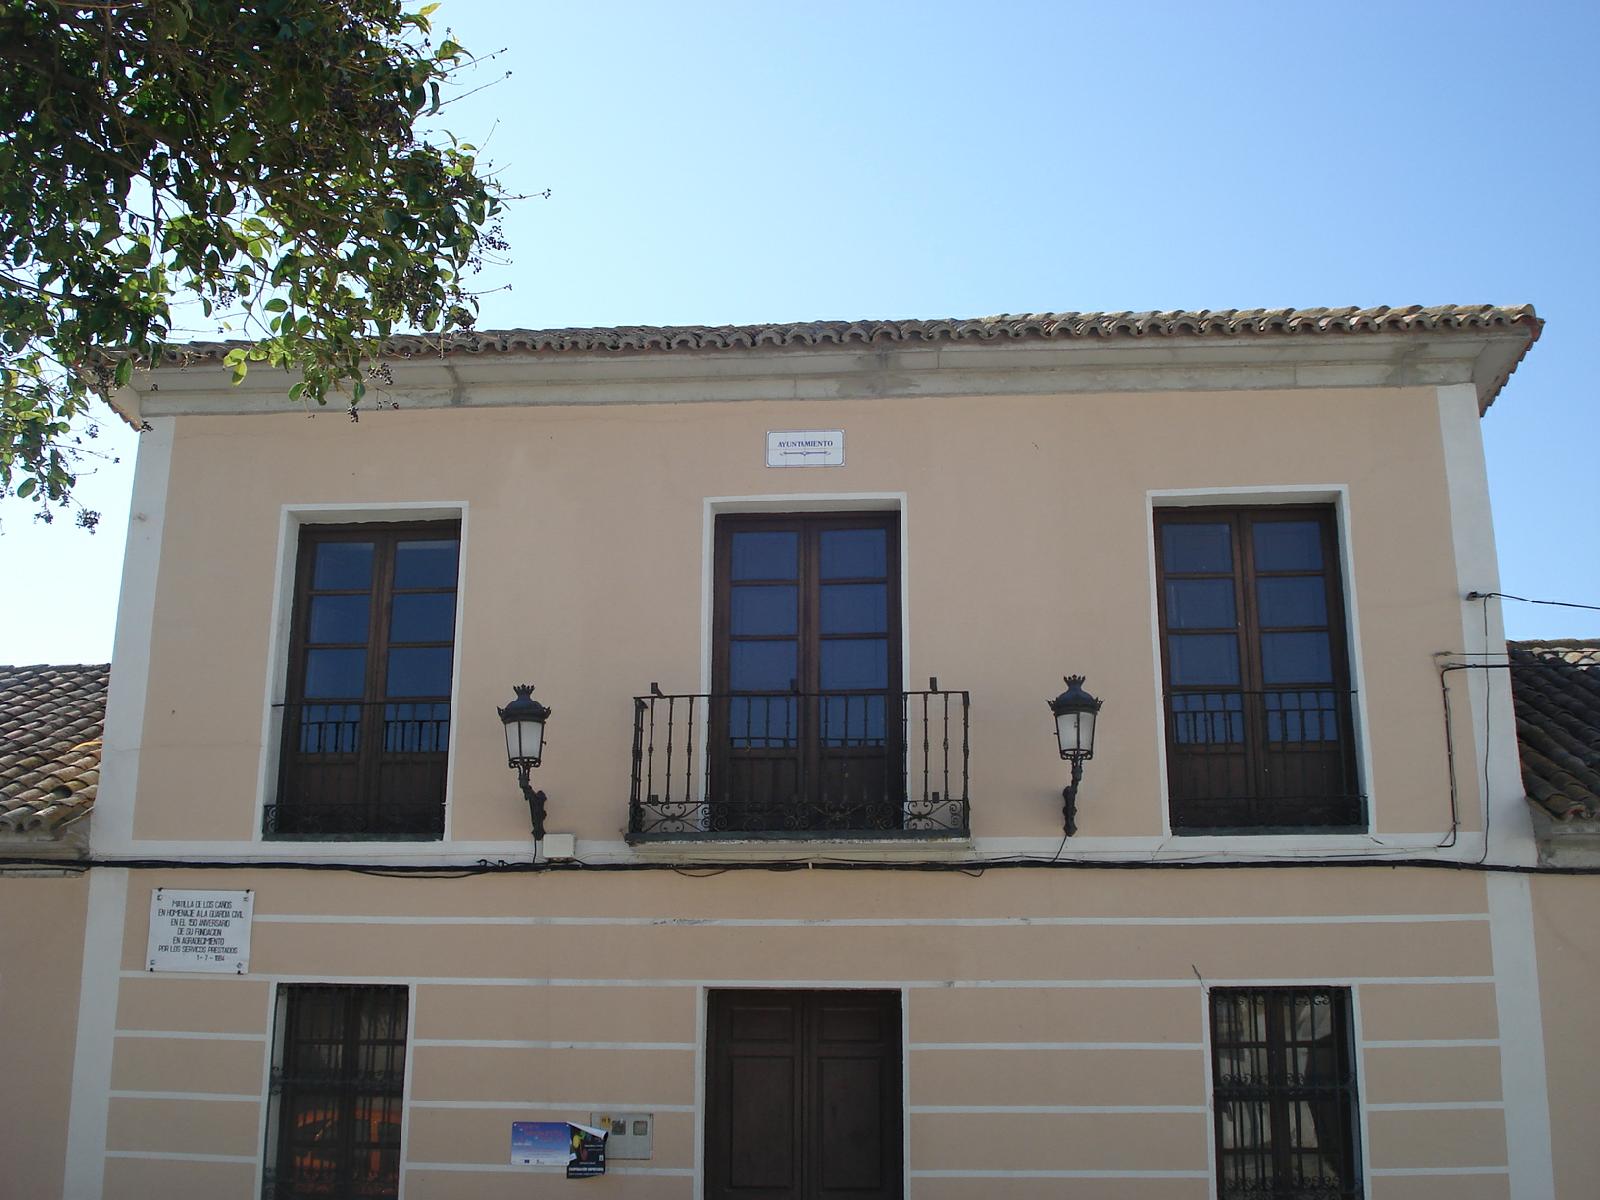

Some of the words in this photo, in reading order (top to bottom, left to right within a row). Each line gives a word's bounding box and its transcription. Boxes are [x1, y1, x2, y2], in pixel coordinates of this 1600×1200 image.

[167, 909, 195, 917] HOMENAJE
[209, 910, 230, 918] GUARDIA
[199, 919, 230, 927] ANIVERSARIO
[182, 937, 224, 945] AGRADECIMIENTO
